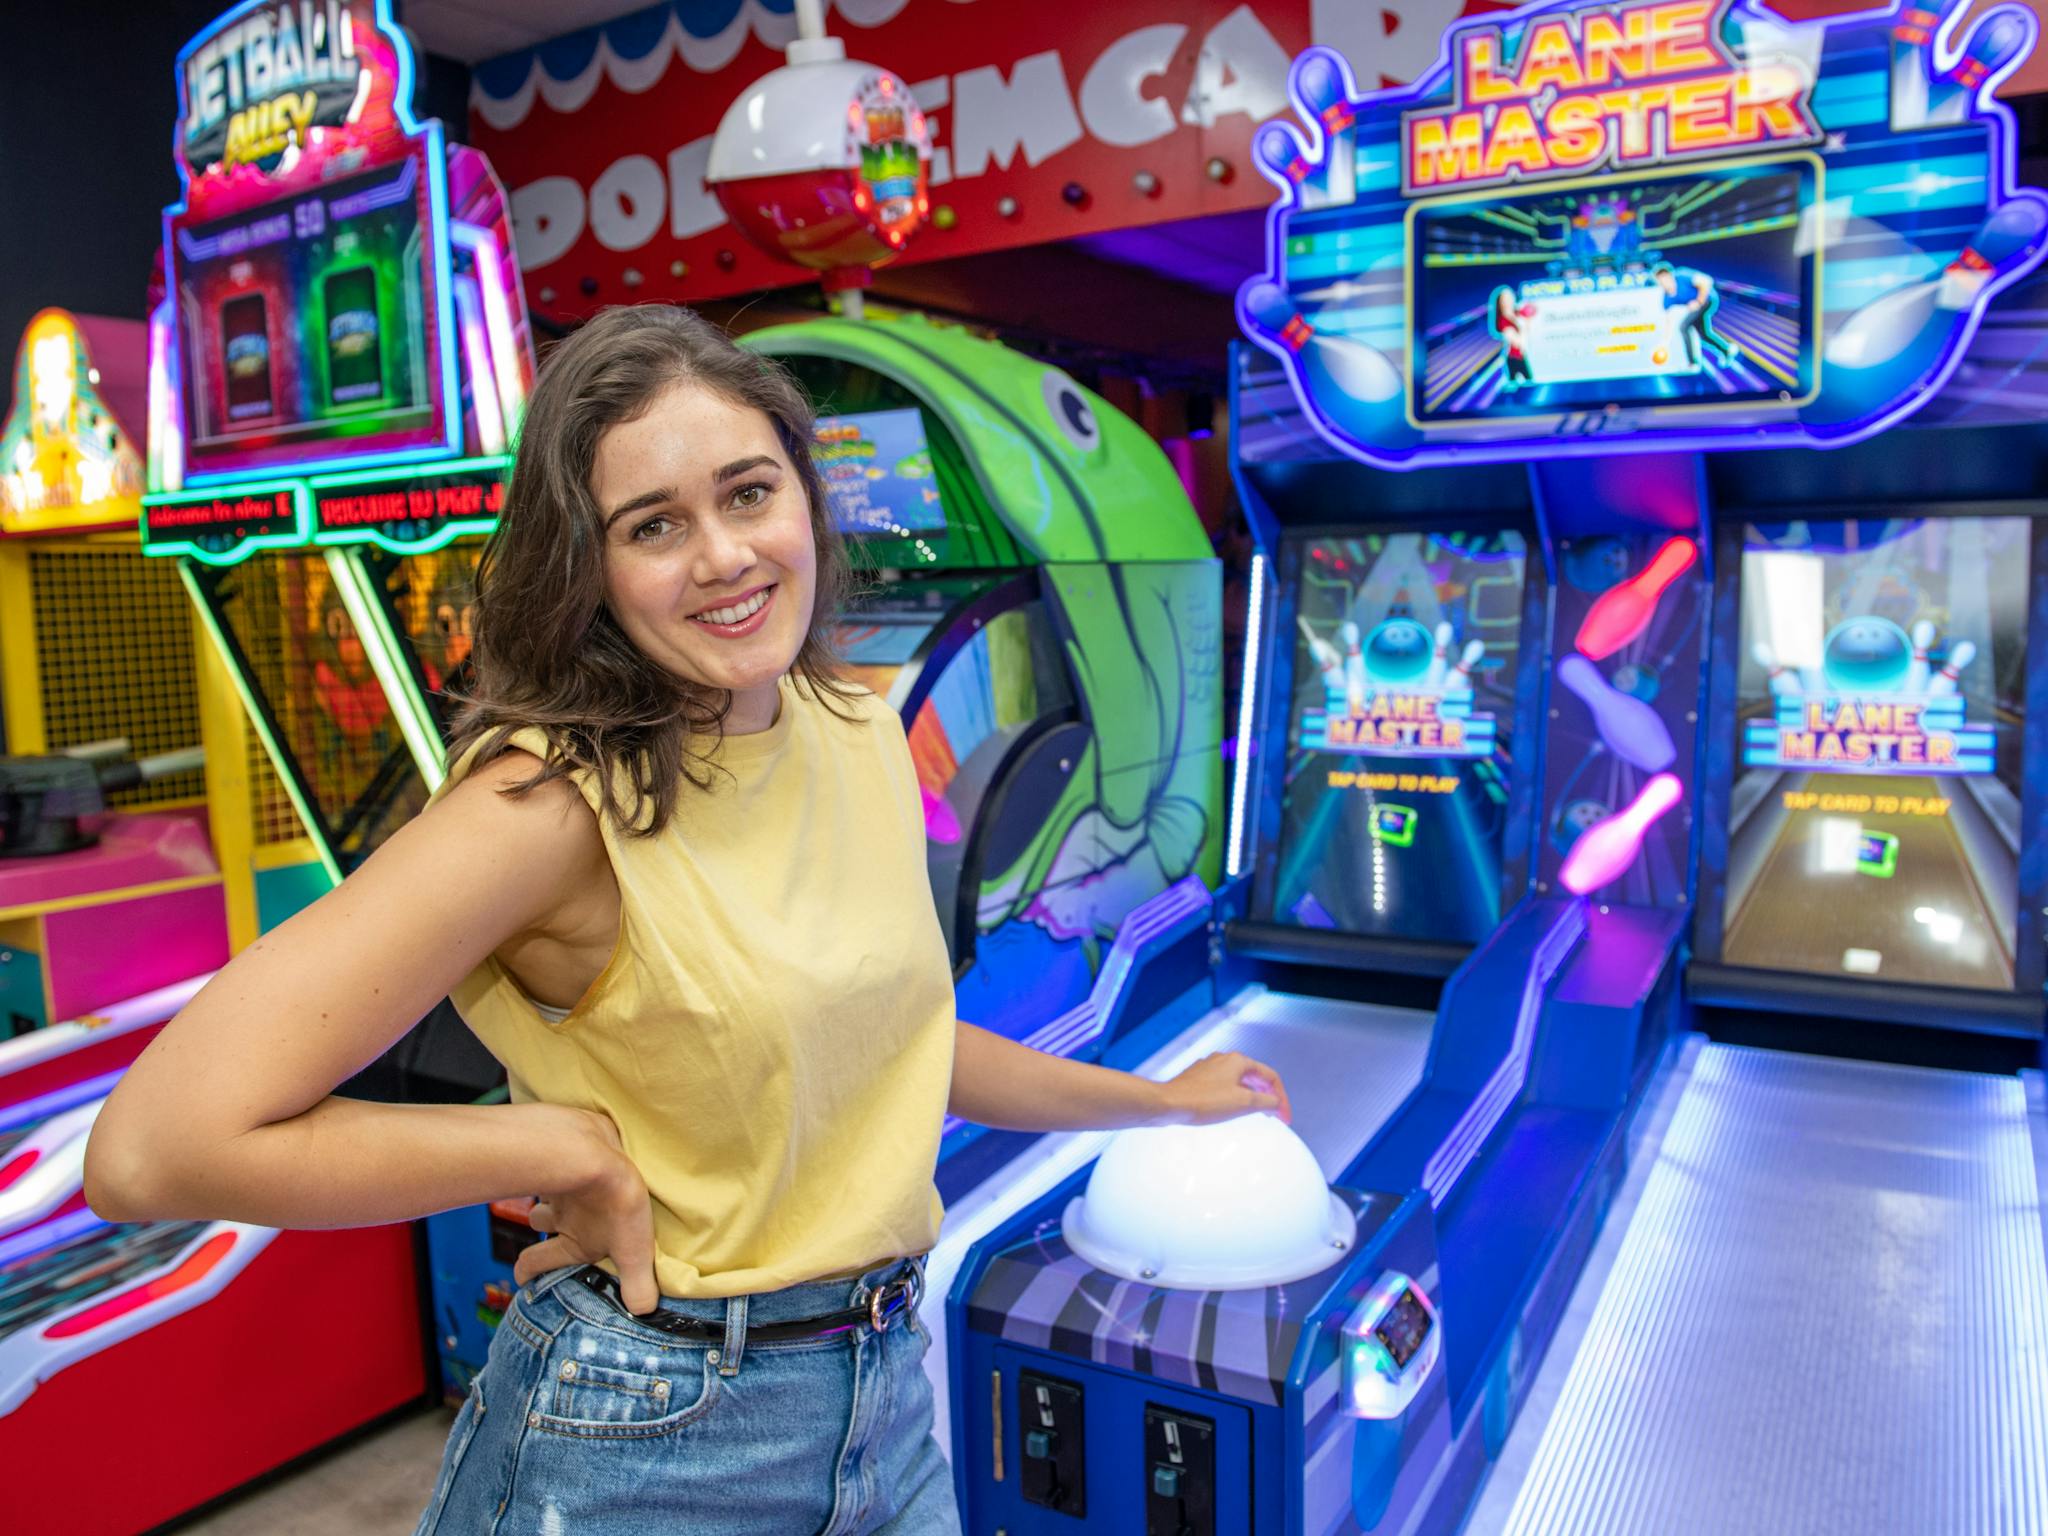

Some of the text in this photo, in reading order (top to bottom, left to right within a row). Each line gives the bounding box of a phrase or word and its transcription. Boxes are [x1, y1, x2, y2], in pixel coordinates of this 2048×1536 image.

[1466, 0, 1724, 104] LANE
[185, 0, 361, 145] JETBALL
[224, 90, 318, 174] ALLEY
[1411, 62, 1810, 187] MASTER
[1350, 693, 1441, 721] LANE
[1808, 701, 1923, 734] LANE
[1329, 718, 1464, 748] MASTER
[1782, 731, 1956, 765] MASTER
[1782, 791, 1952, 816] TAP CARD TO PLAY
